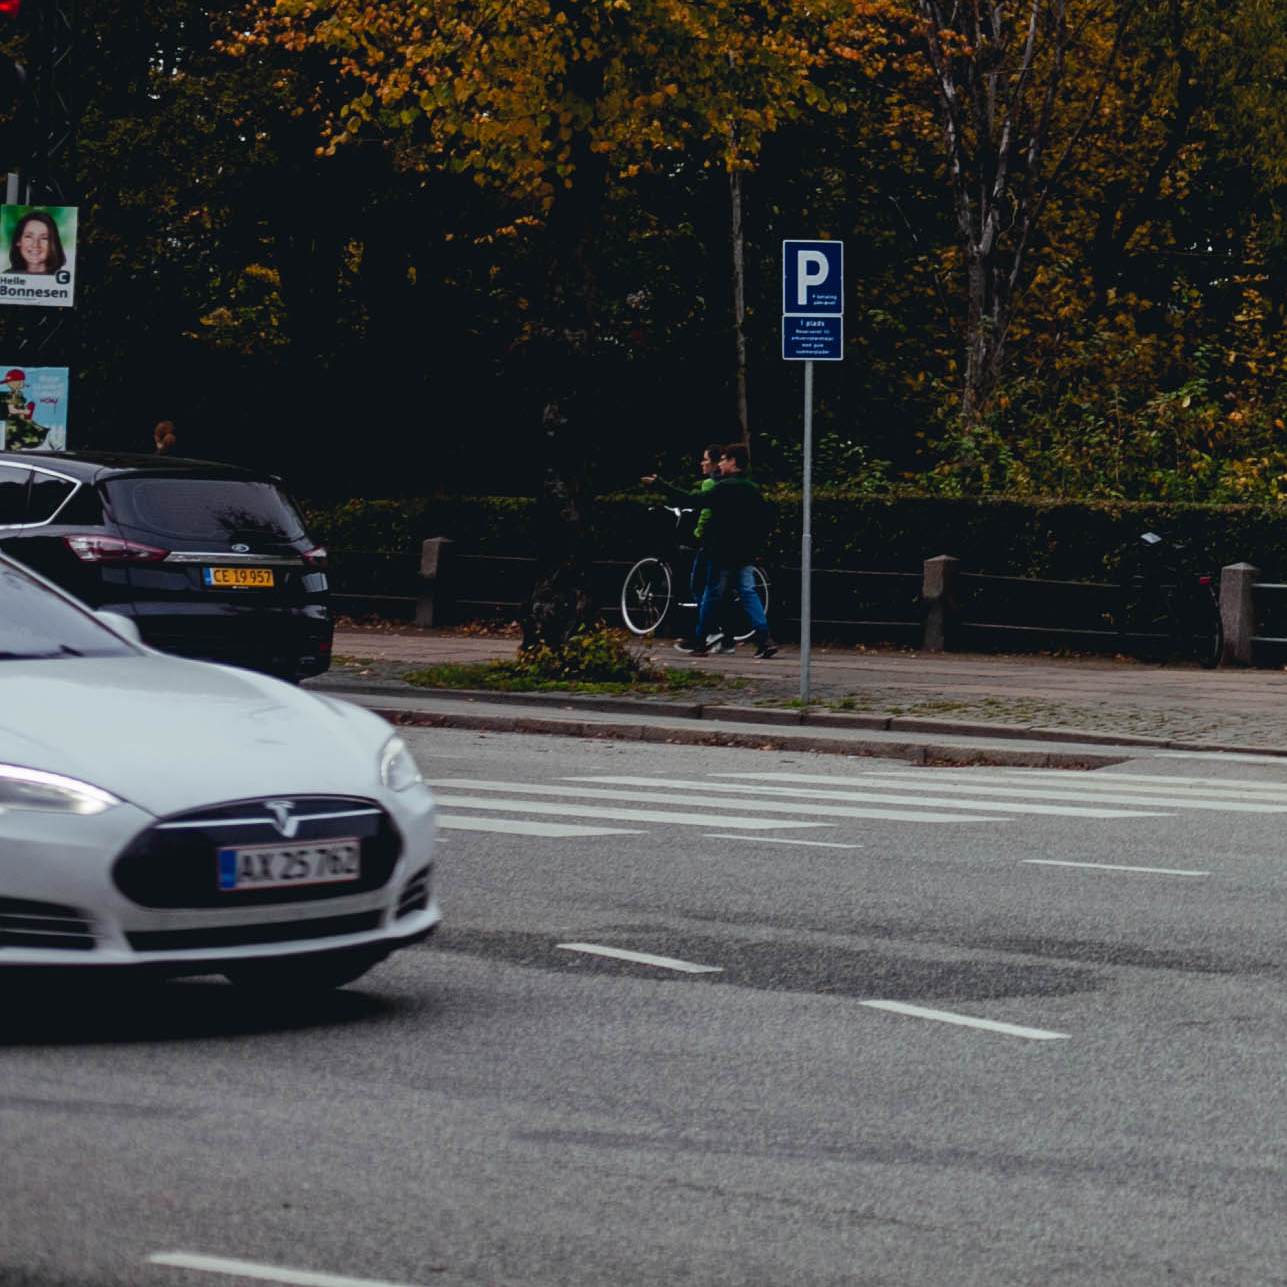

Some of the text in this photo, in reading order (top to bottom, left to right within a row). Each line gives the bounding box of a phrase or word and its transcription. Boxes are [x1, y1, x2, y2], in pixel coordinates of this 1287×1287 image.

[0, 277, 26, 285] Helle
[798, 250, 829, 305] P
[0, 286, 68, 298] Bonnesen
[213, 569, 230, 582] CE
[238, 845, 358, 882] AX 25 762
